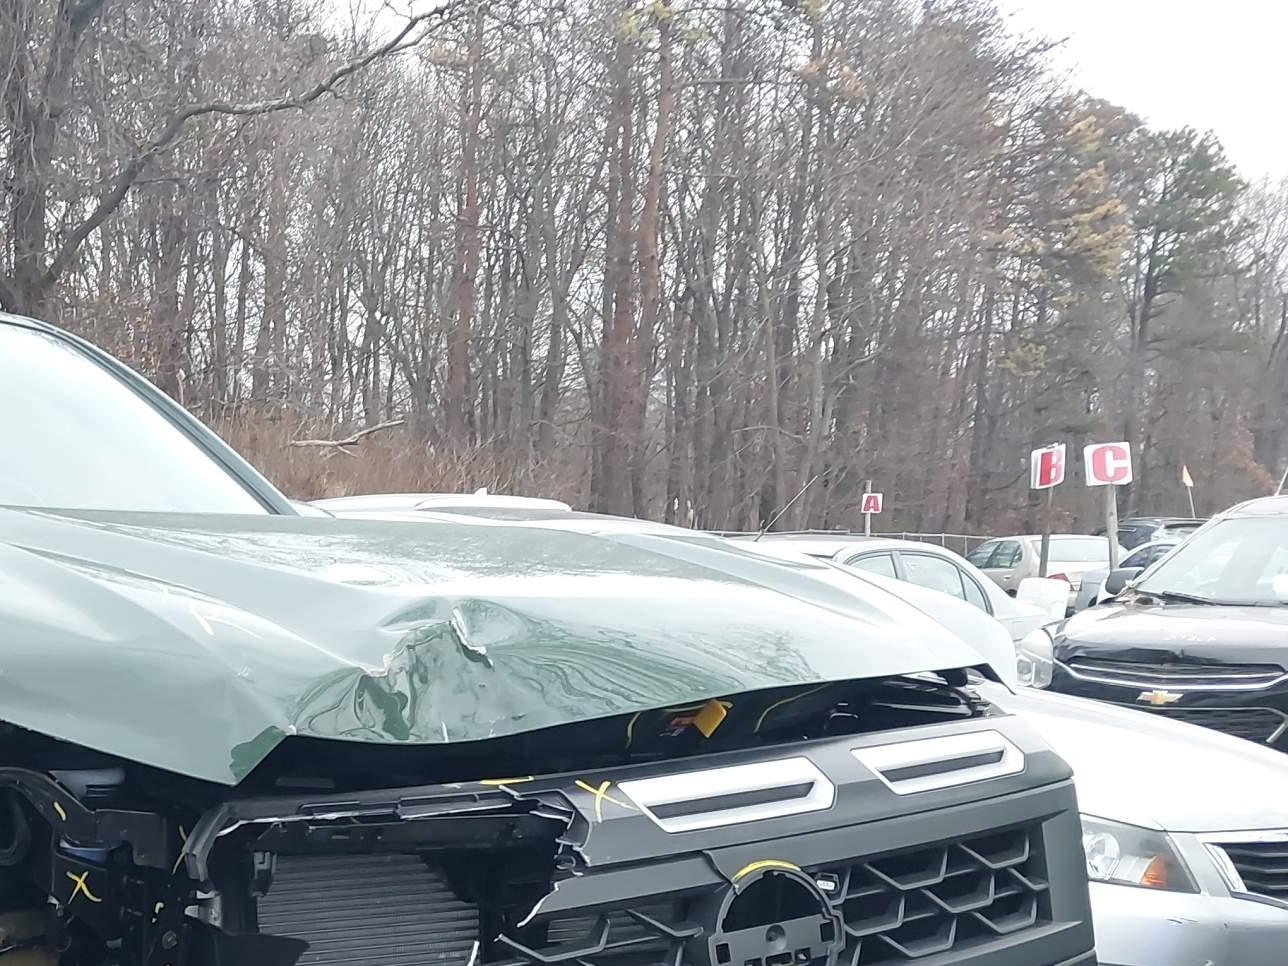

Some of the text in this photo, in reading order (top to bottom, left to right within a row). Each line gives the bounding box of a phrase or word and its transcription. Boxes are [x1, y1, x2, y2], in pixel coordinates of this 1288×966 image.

[1038, 450, 1064, 486] B
[1092, 445, 1129, 482] C
[863, 495, 881, 511] A
